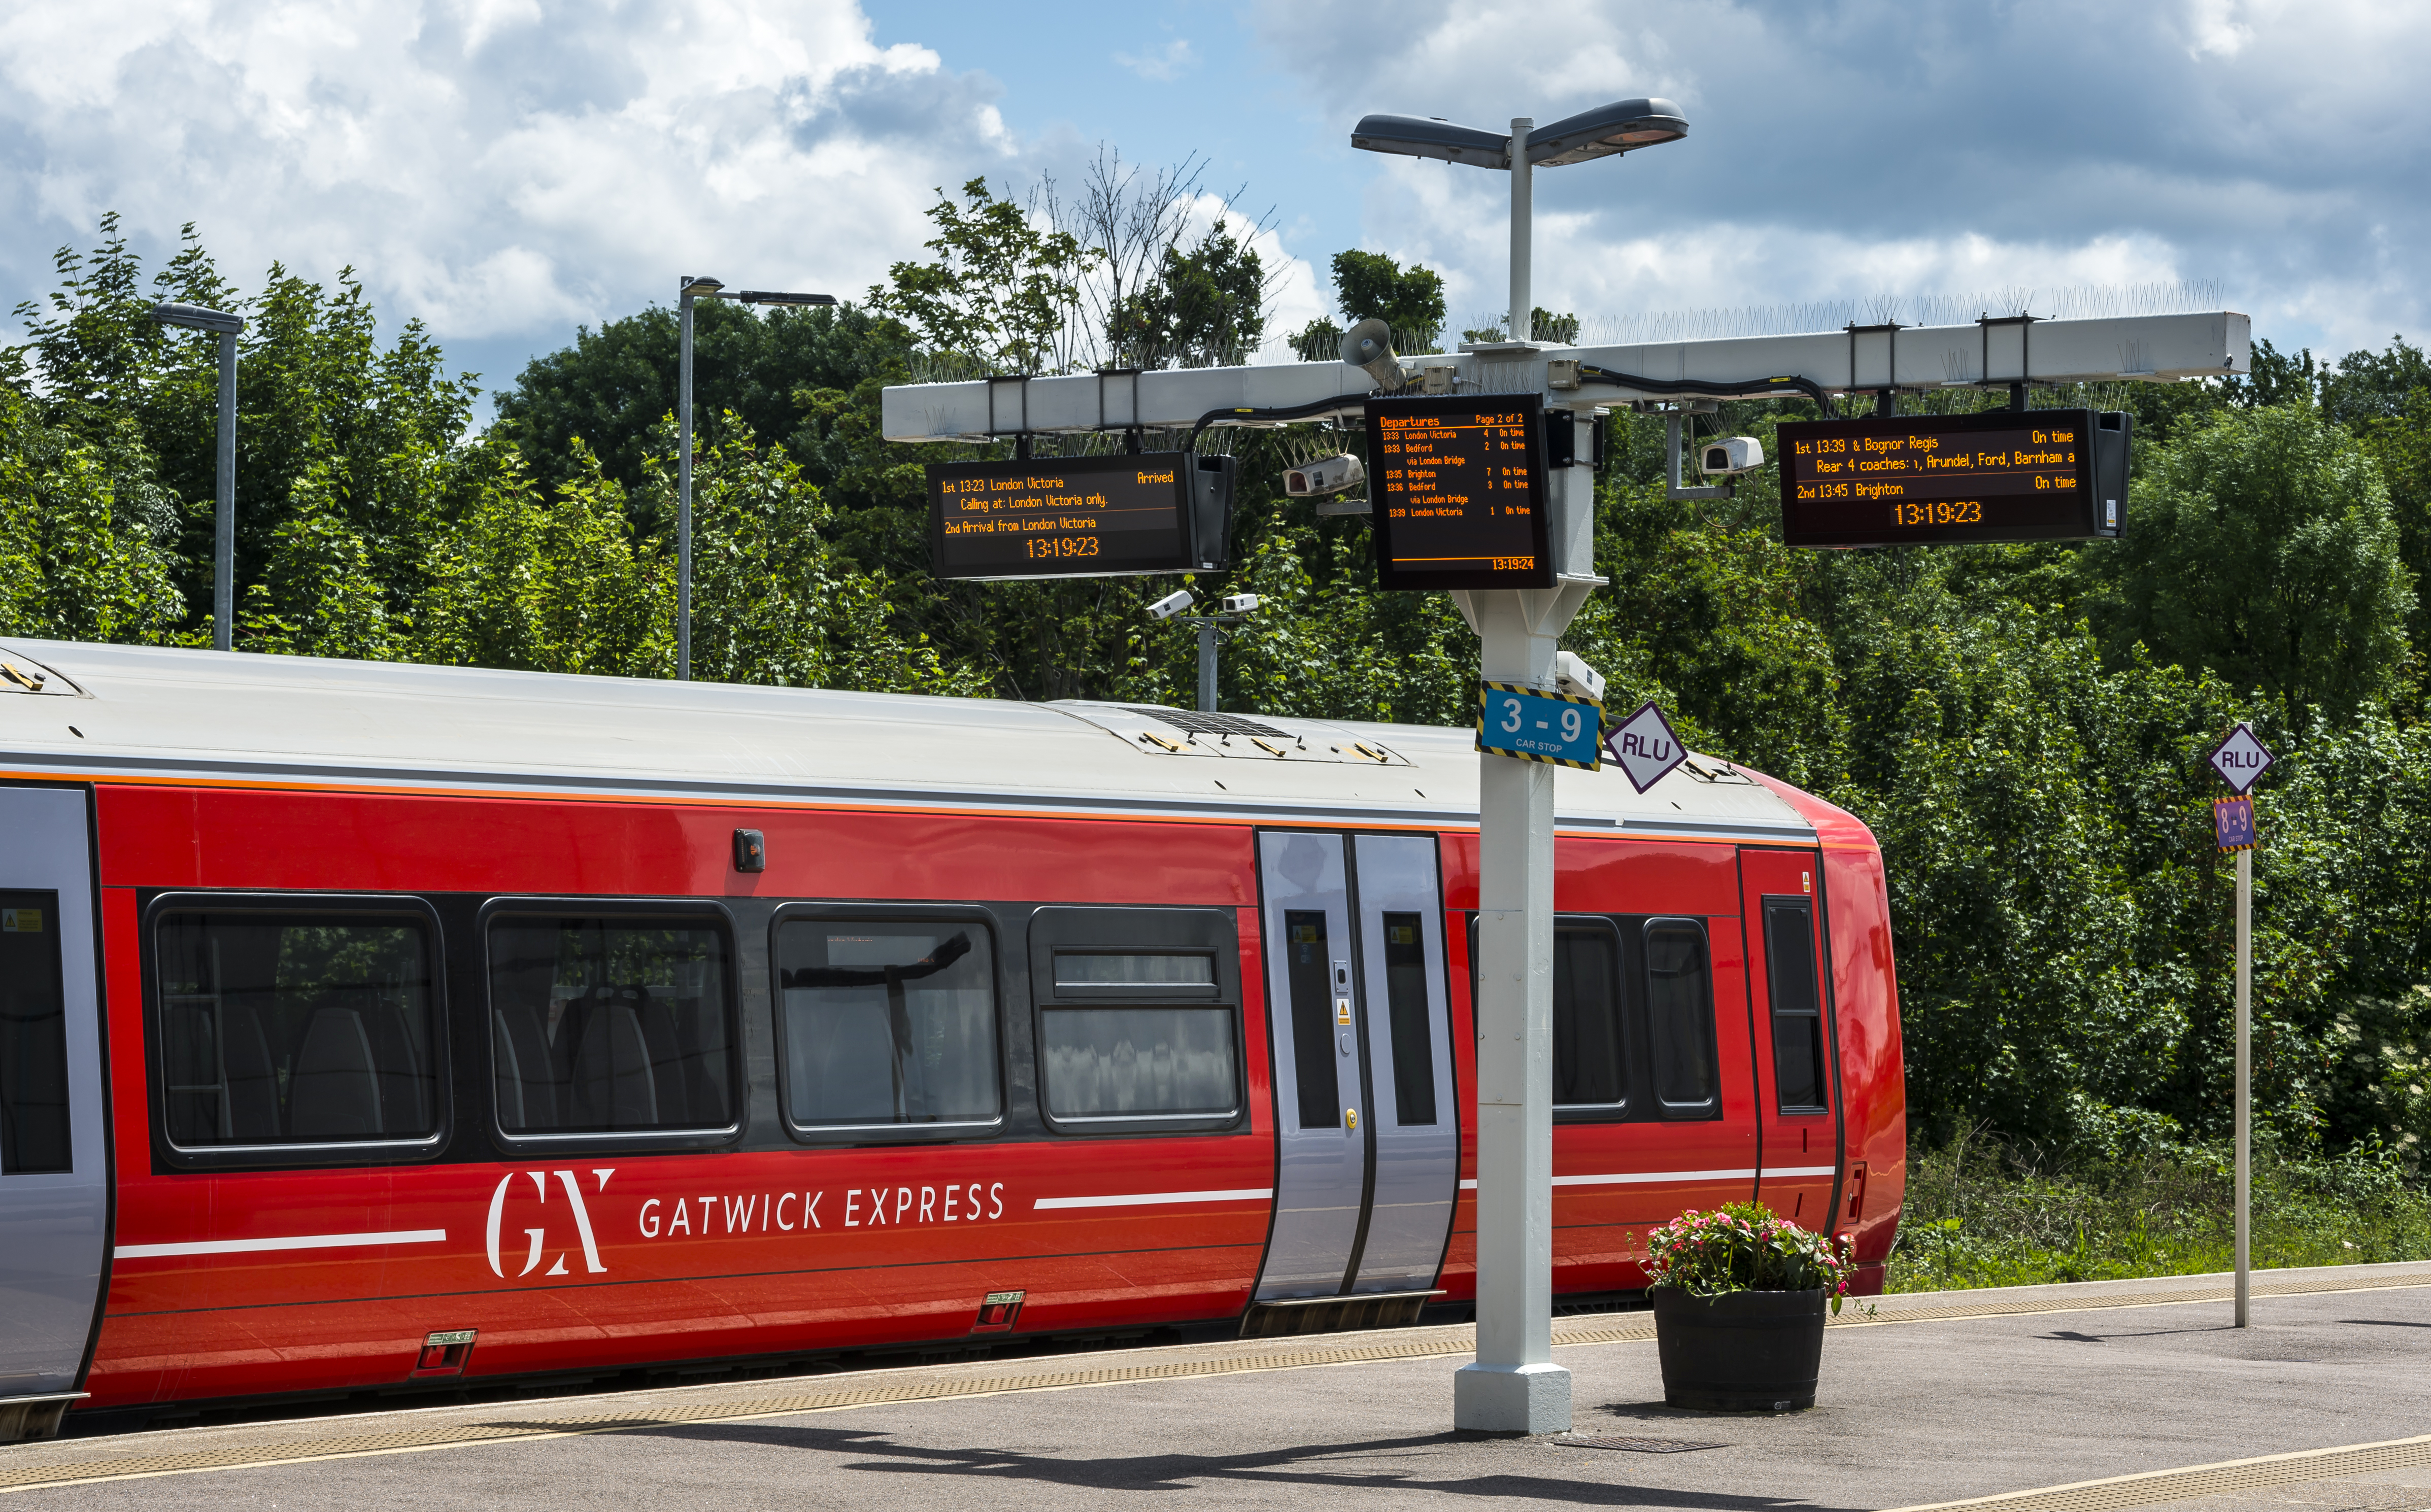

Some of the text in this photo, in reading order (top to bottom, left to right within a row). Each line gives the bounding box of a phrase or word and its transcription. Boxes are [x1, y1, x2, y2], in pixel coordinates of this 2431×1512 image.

[1380, 416, 1440, 428] Departures
[1475, 413, 1523, 426] Page 2 of 2
[1383, 428, 1525, 440] 13:33 London Victoria 4 On time
[2032, 430, 2074, 443] On time
[1384, 440, 1525, 453] 13:33 Bedford 2 On time
[1795, 436, 1938, 455] 1st 13:39 & Bognor Regis
[1407, 455, 1465, 466] via London Bridge
[1816, 460, 1843, 473] Rear
[1848, 460, 1855, 472] 4
[1860, 457, 1909, 471] coaches:
[1927, 453, 1974, 469] Arundel,
[1978, 452, 2010, 468] Ford,
[2014, 451, 2063, 465] Barnham
[1137, 470, 1174, 484] Arrived
[1386, 467, 1527, 480] 13:35 Brighton 7 On time
[942, 477, 1064, 493] 1st 13:23 London Victoria
[1387, 479, 1528, 492] 13:36 Bedford 3 On time
[2035, 475, 2076, 489] On time
[1797, 482, 1903, 499] 2nd 13:45 Brighton
[961, 492, 1108, 513] Calling at: London Victoria only.
[1410, 494, 1468, 505] via London Bridge
[1389, 506, 1530, 518] 13:39 London Victoria 1 On time
[1895, 501, 1982, 525] 13:19:23
[944, 517, 1096, 534] 2nd Arrival from London Victoria
[1026, 536, 1099, 558] 13:19:23
[1492, 558, 1534, 570] 13:19:24
[1501, 698, 1522, 733] 3
[1560, 708, 1581, 742] 9
[1515, 738, 1562, 753] CAR STOP
[1622, 732, 1671, 762] RLU
[2222, 751, 2259, 768] RLU
[2221, 808, 2229, 834] 8
[2239, 805, 2247, 831] 9
[639, 1183, 1004, 1238] GATWICK EXPRESS
[485, 1168, 616, 1279] GX
